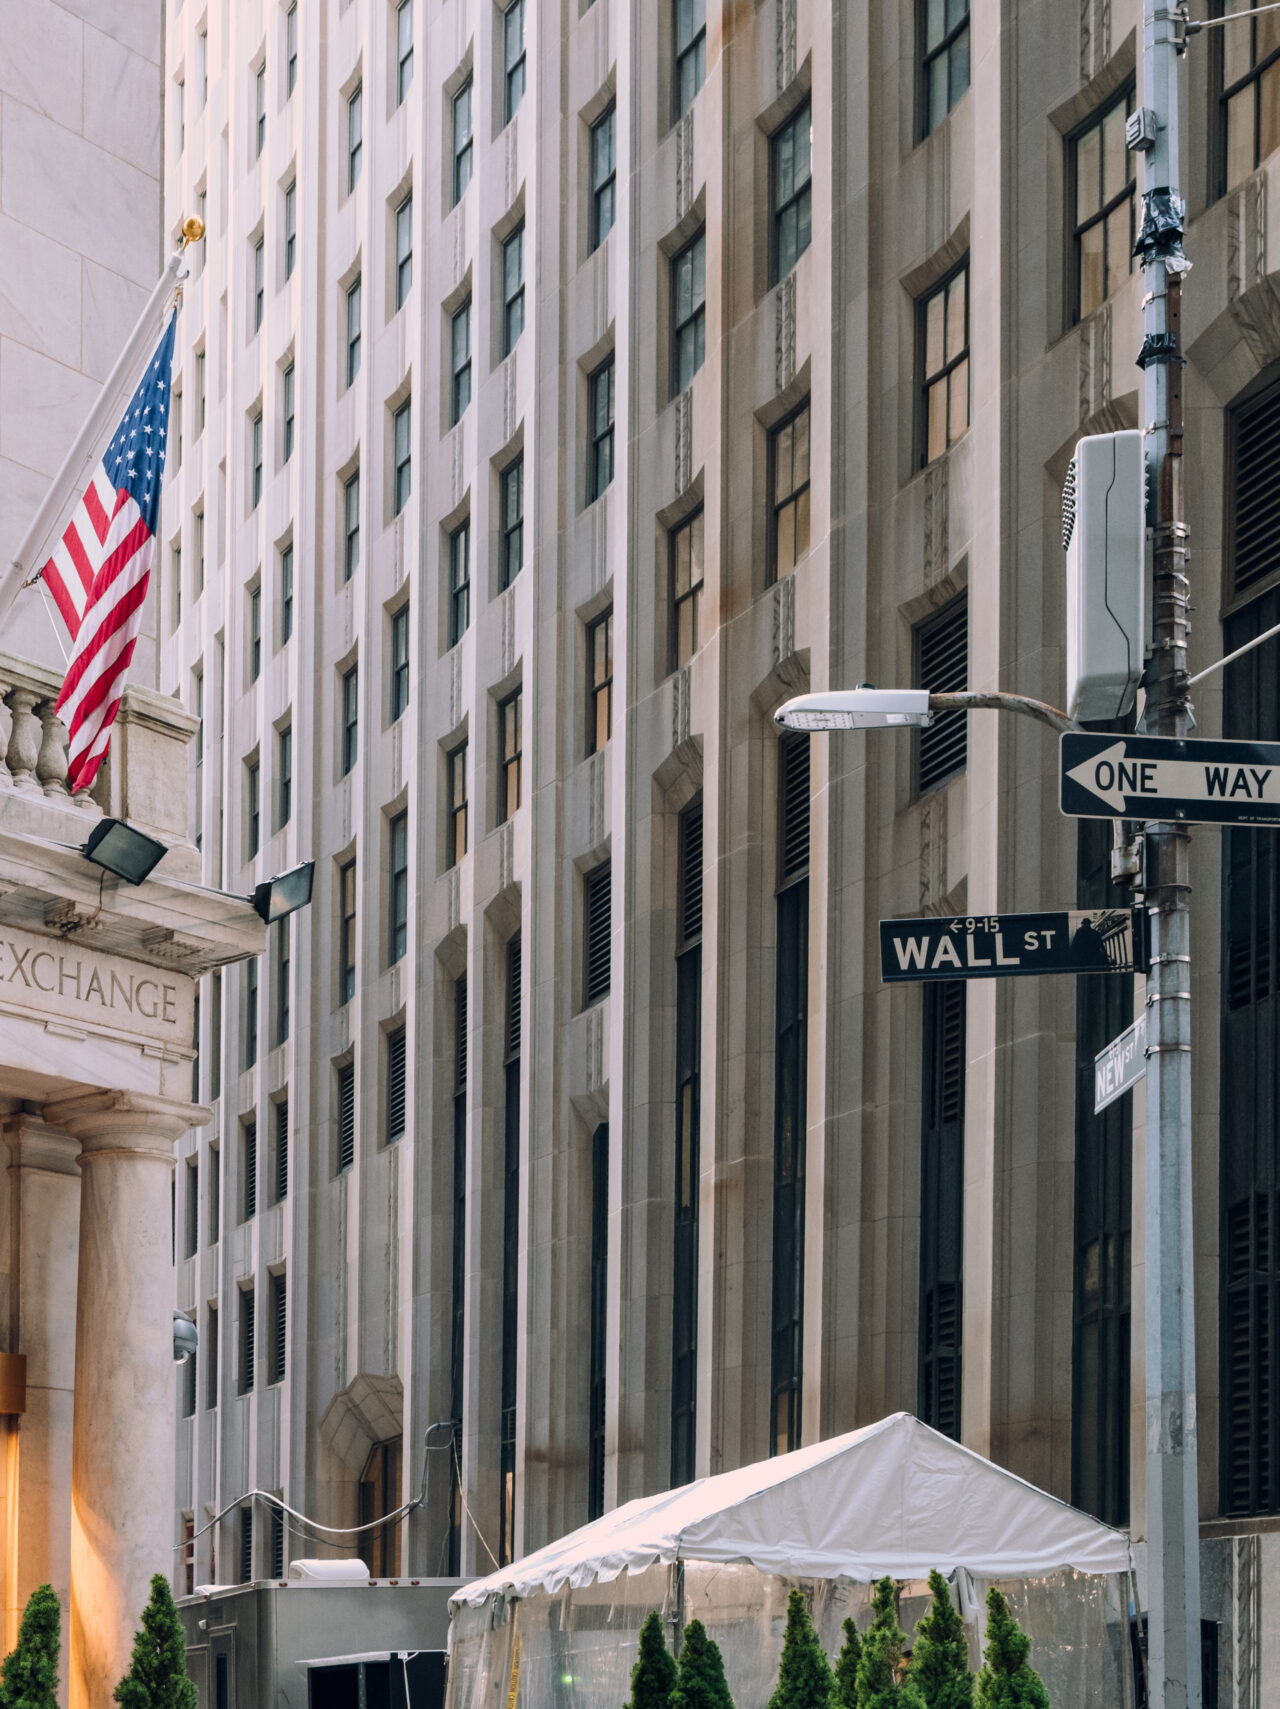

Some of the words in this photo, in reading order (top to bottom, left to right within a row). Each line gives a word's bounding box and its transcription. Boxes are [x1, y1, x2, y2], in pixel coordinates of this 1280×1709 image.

[1095, 760, 1158, 793] ONE
[1204, 766, 1272, 798] WAY
[965, 917, 1000, 934] 9-15
[893, 932, 1021, 971] WALL
[1024, 930, 1056, 951] ST
[1097, 1053, 1125, 1102] NEW
[1125, 1042, 1134, 1064] ST
